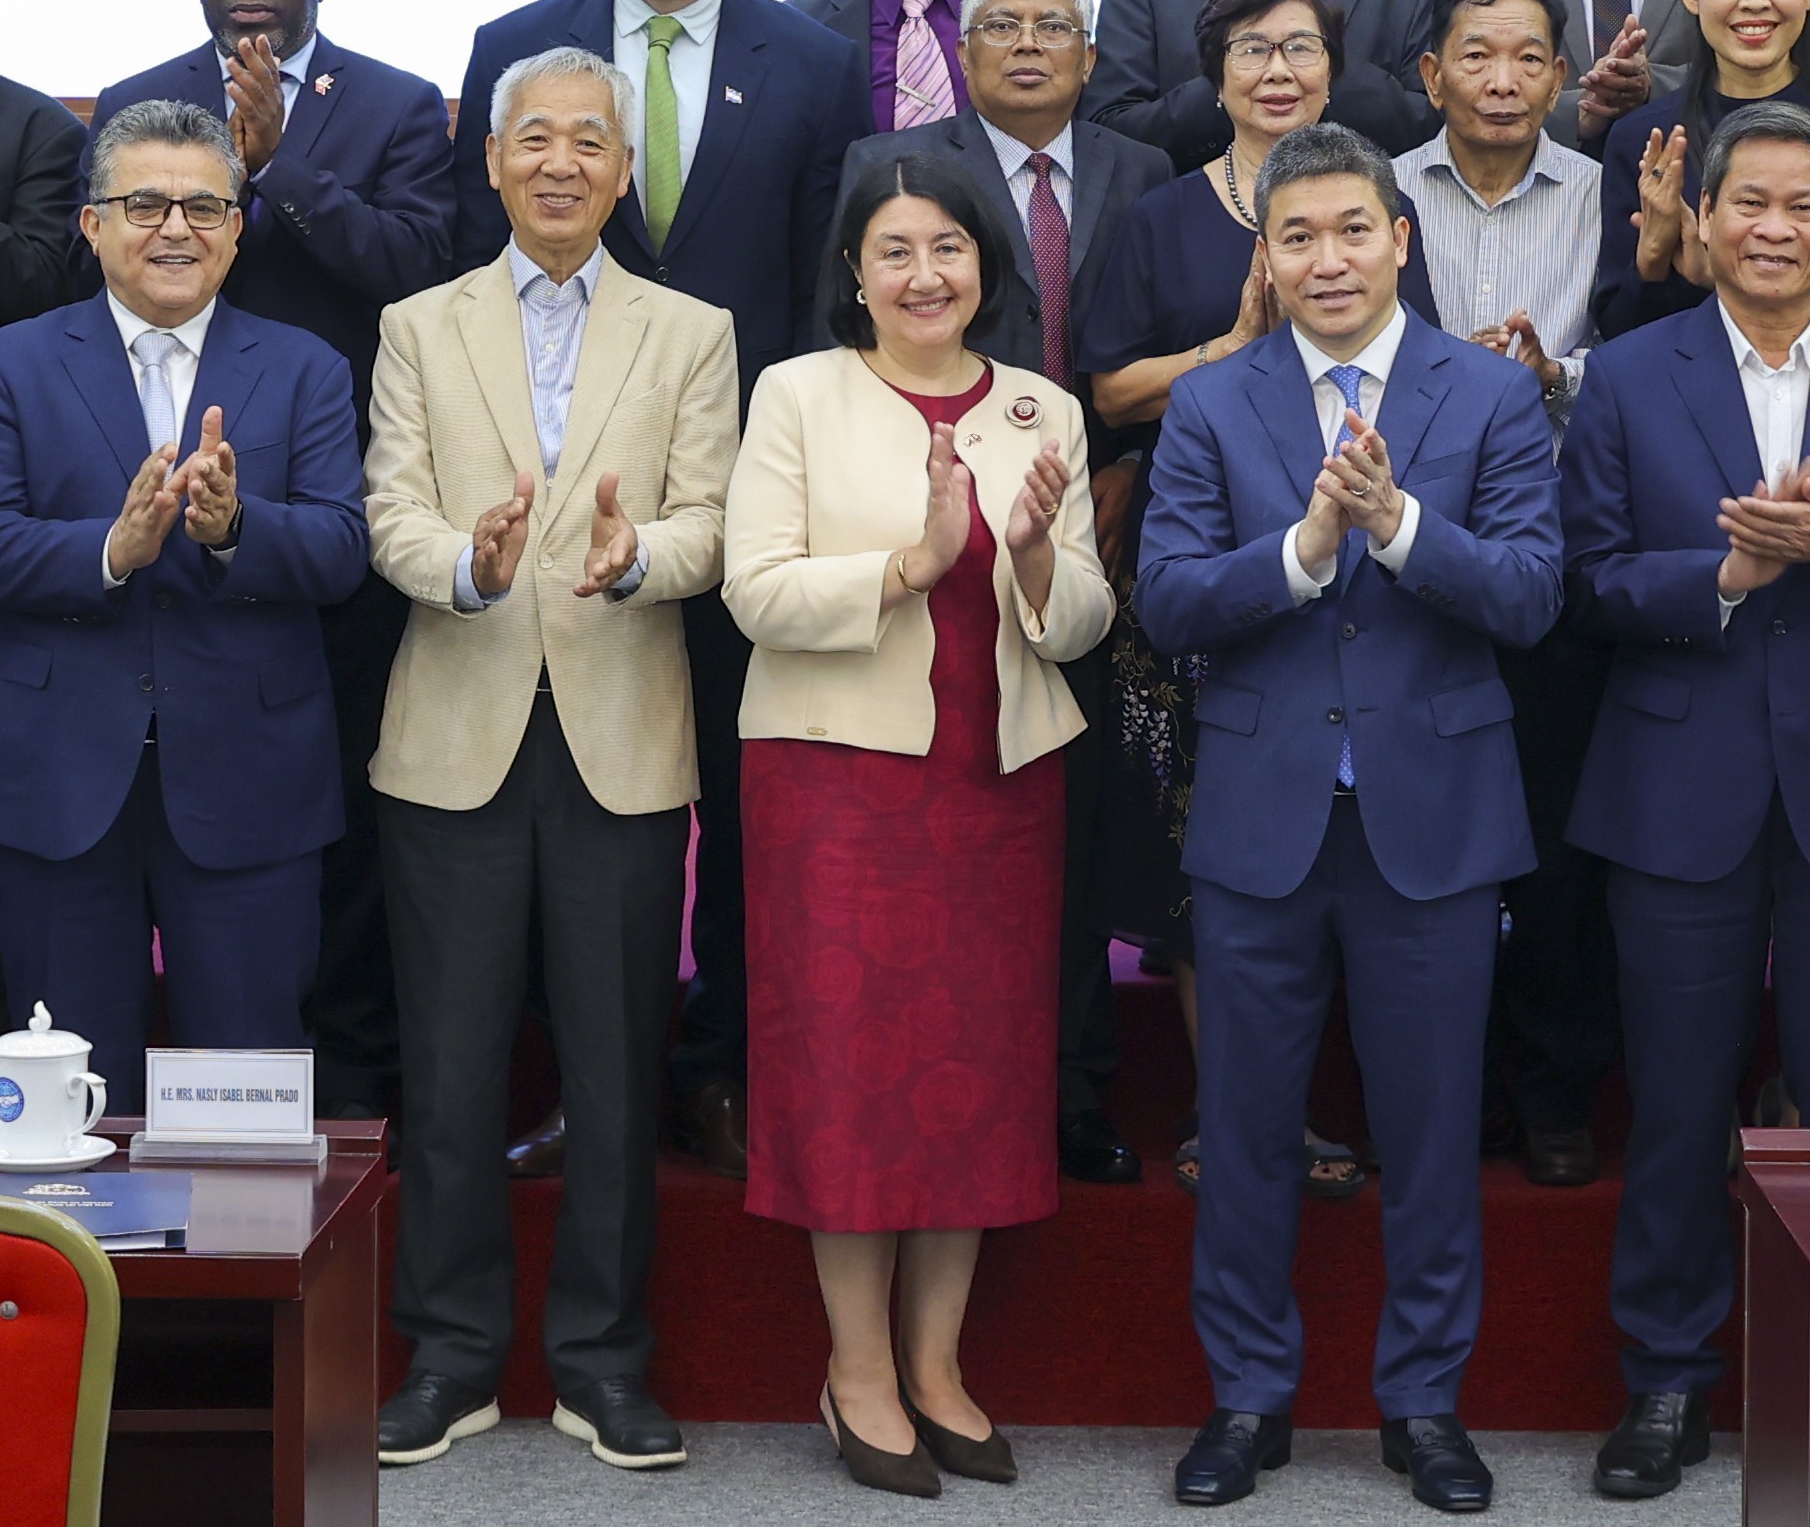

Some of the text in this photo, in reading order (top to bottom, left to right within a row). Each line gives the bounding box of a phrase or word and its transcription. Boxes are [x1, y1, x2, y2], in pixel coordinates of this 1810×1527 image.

[161, 1088, 299, 1103] H.E. MRS. NASLY ISABEL BERNAL PRADO
